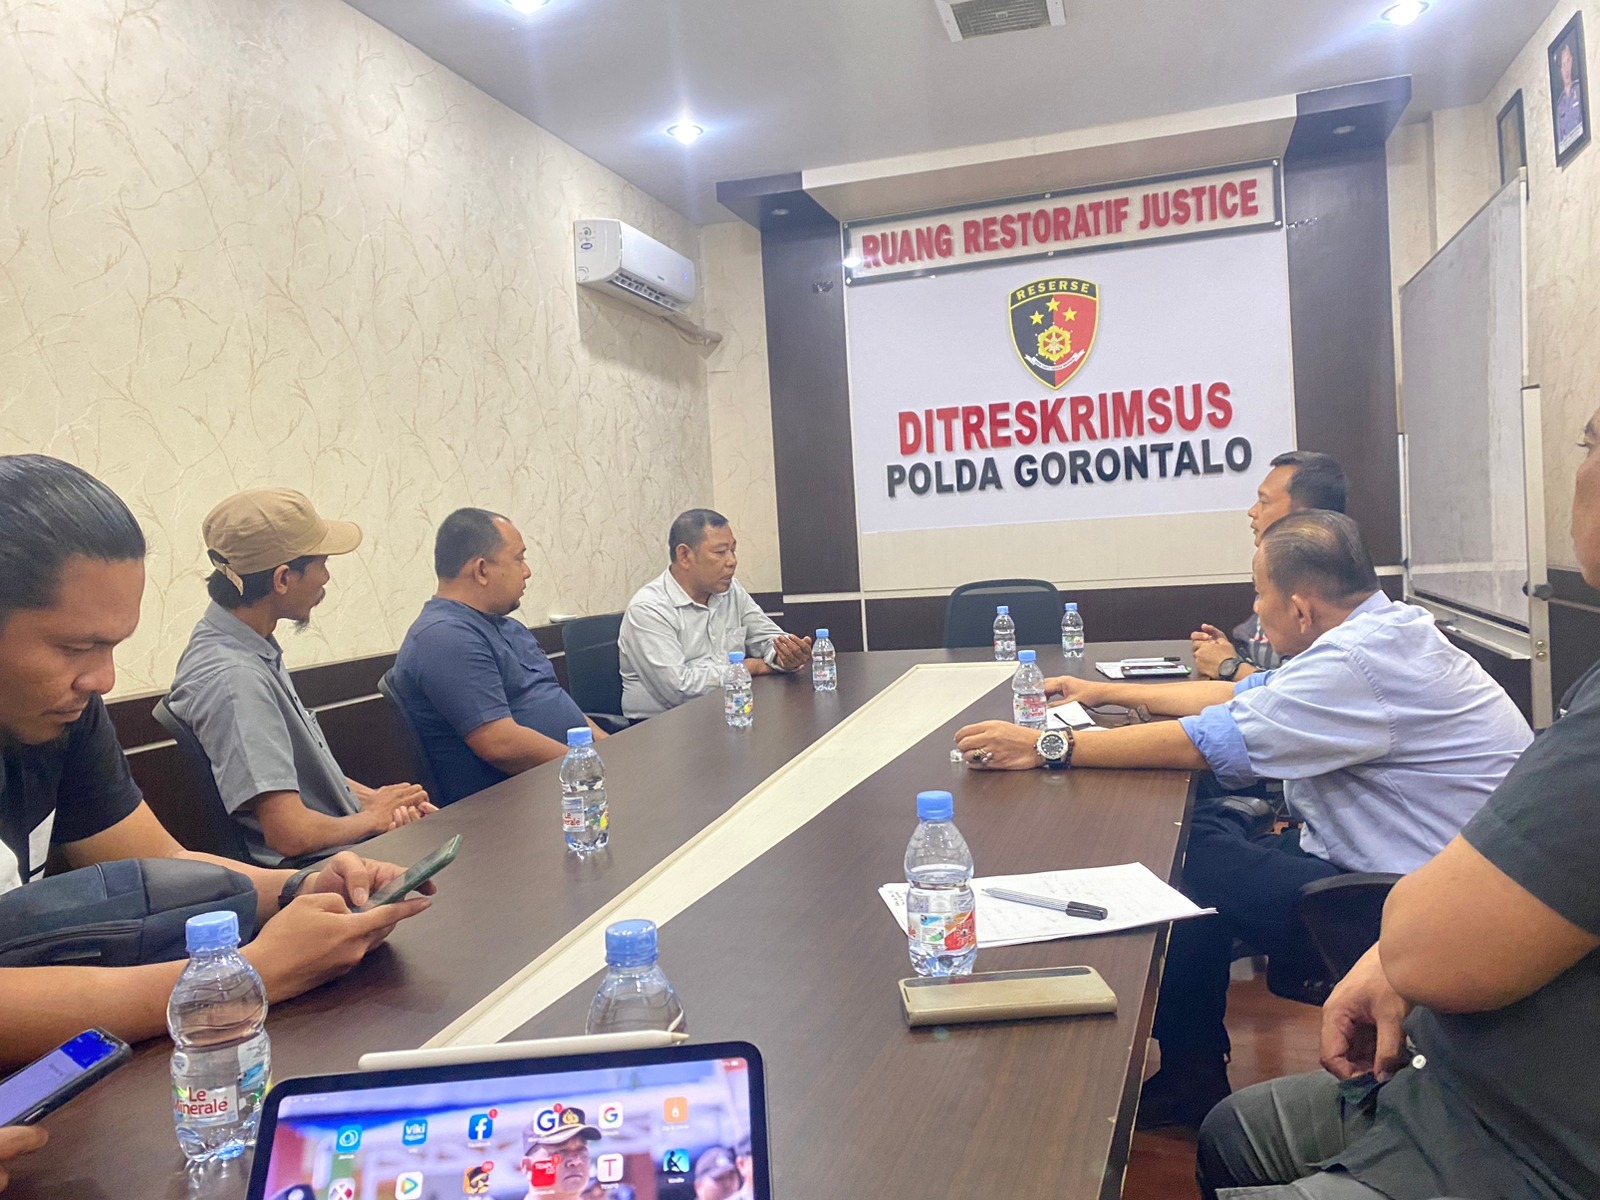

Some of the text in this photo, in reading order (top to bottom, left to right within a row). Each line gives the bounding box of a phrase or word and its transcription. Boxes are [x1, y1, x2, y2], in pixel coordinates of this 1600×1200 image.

[862, 179, 1259, 268] RUANG RESTORATIF JUSTICE
[1016, 280, 1090, 300] RESERSE
[898, 382, 1234, 456] DITRESKRIMSUS
[886, 436, 1253, 498] POLDA GORONTALO
[188, 1086, 206, 1102] Le
